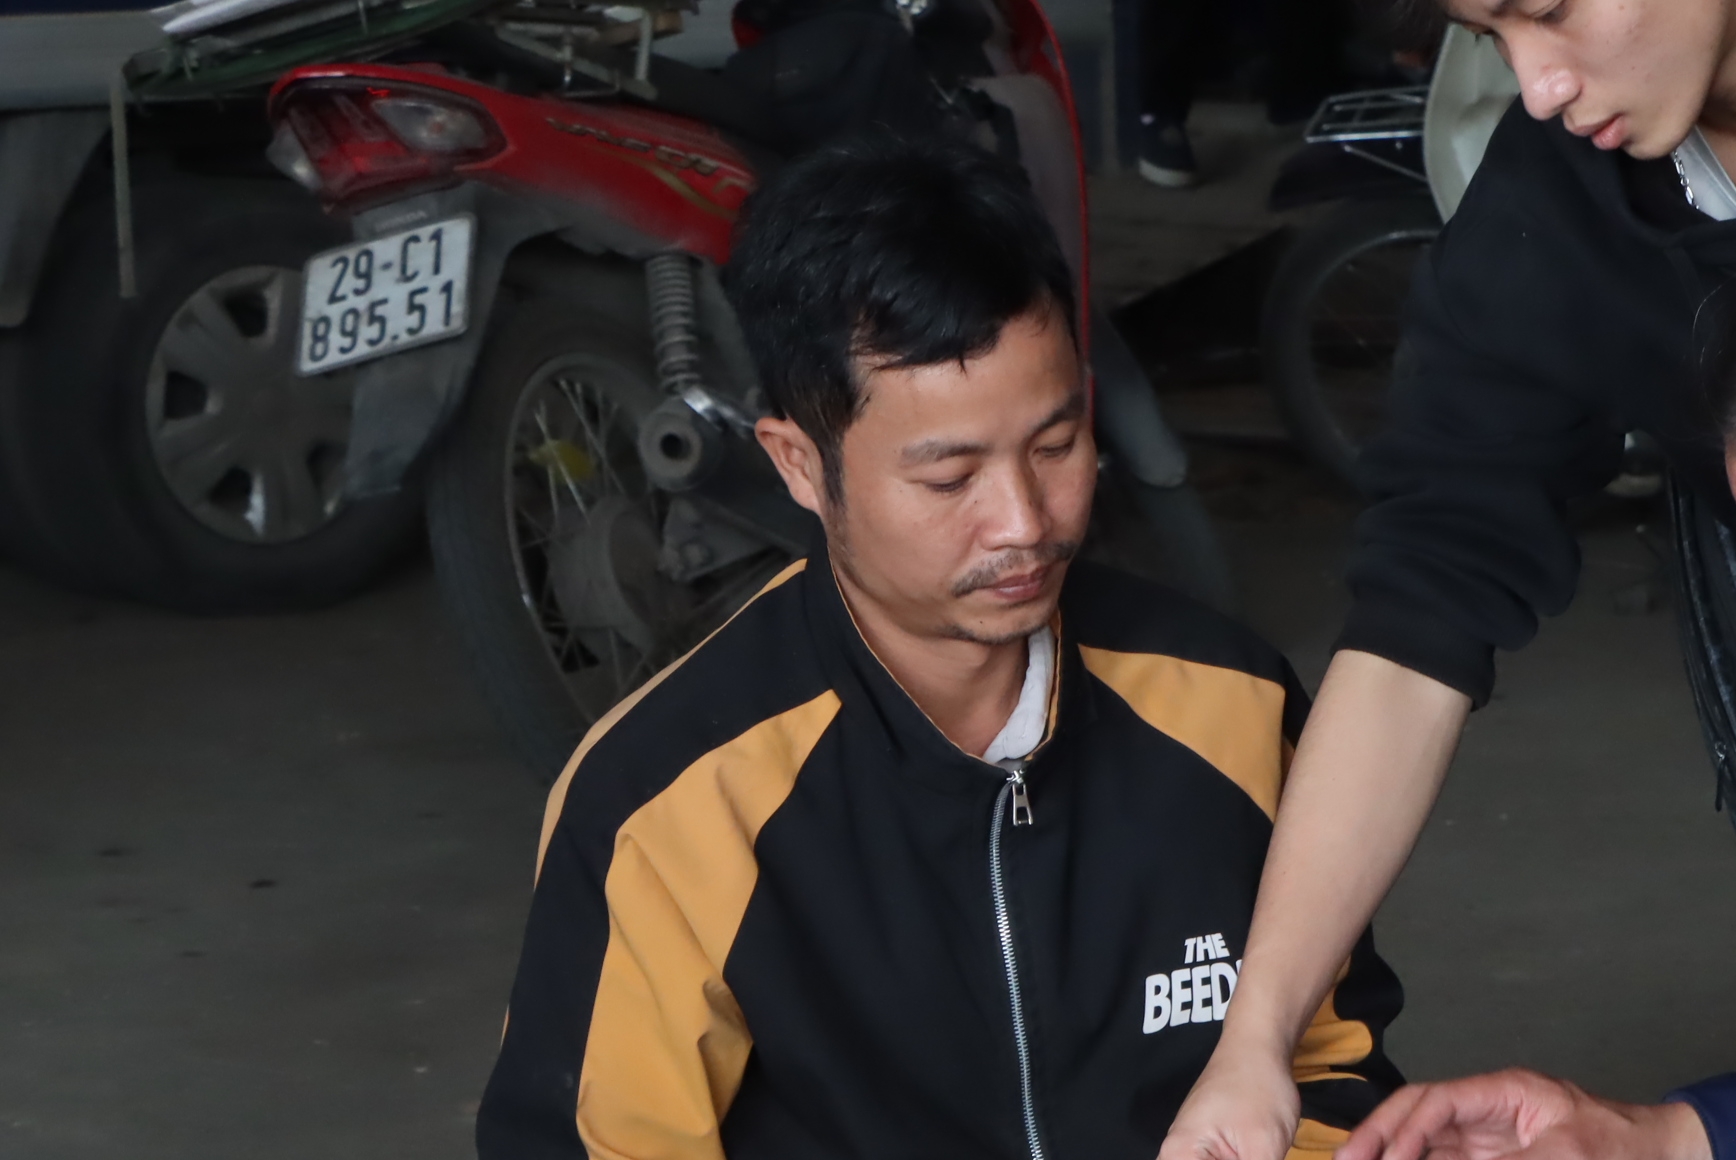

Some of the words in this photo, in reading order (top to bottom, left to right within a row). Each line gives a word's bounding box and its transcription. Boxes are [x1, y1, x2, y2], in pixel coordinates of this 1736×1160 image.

[327, 227, 443, 306] 29-C1
[308, 279, 454, 363] 895.51
[1184, 932, 1230, 965] THE
[1142, 958, 1244, 1035] BEED
